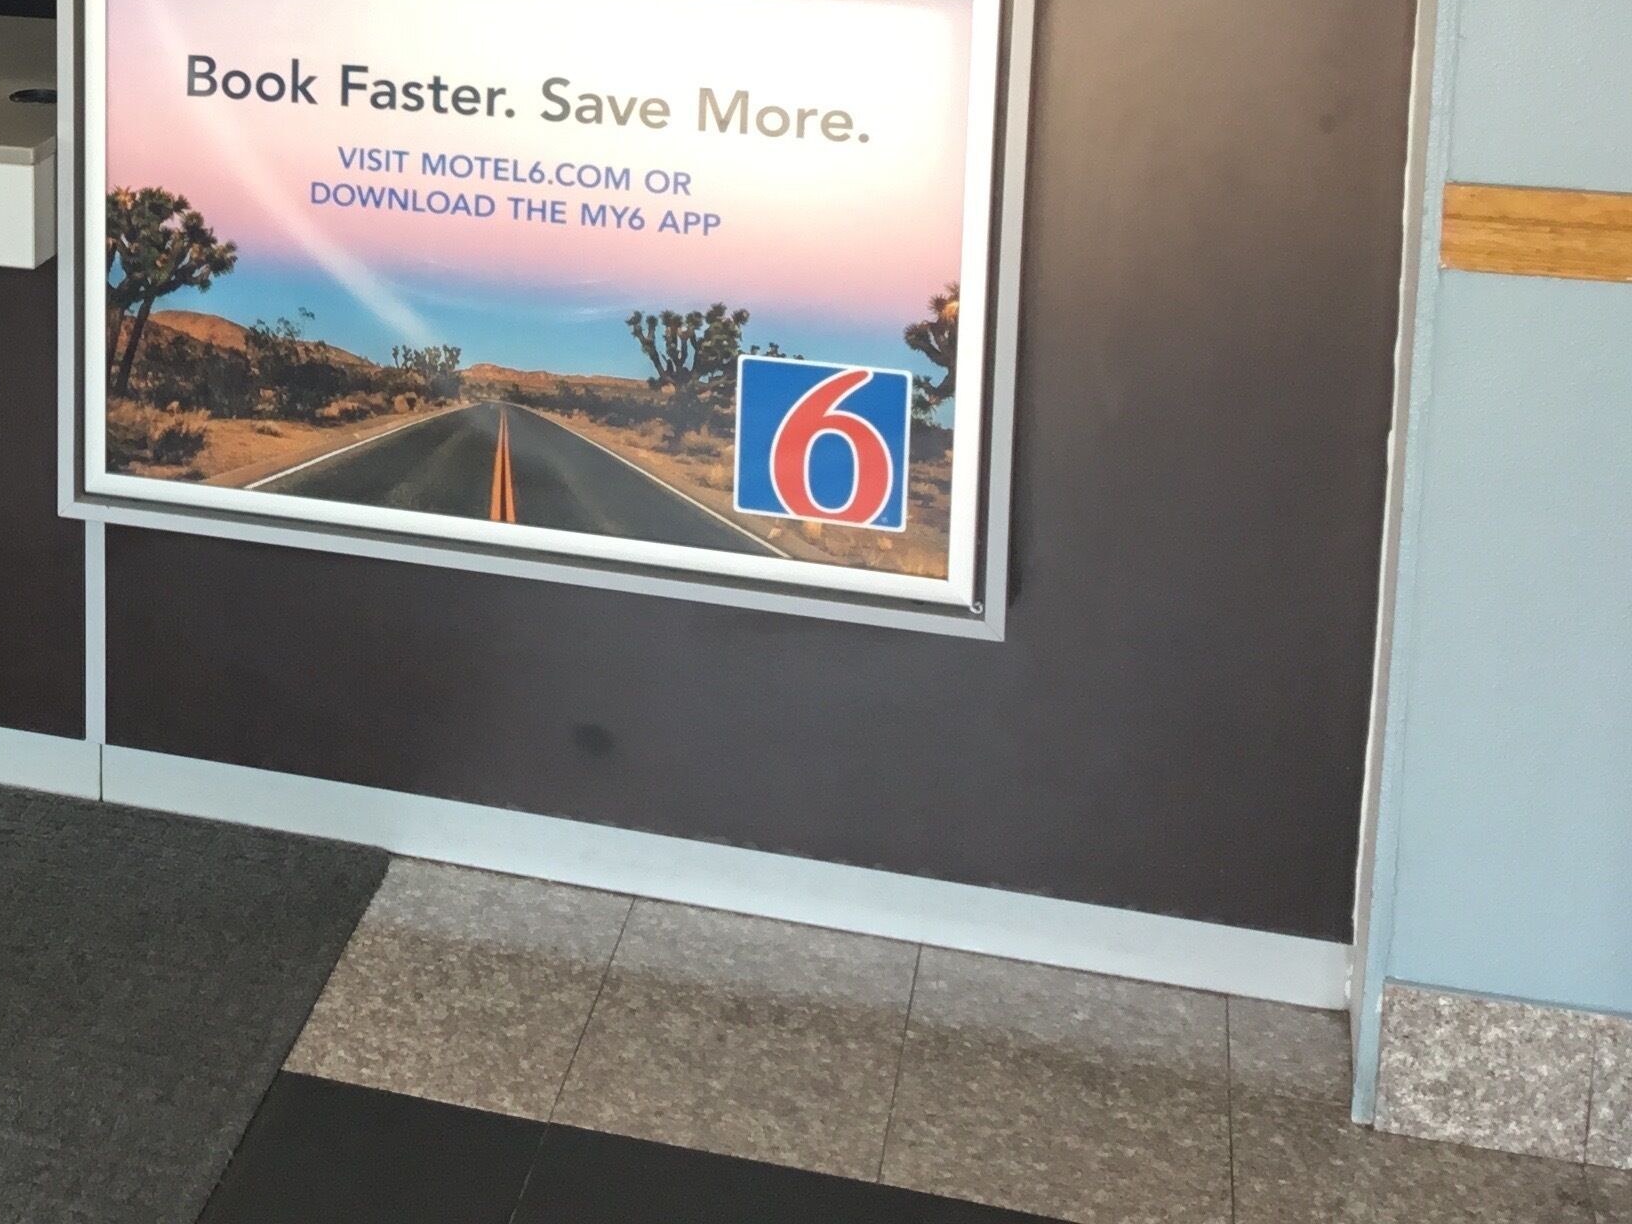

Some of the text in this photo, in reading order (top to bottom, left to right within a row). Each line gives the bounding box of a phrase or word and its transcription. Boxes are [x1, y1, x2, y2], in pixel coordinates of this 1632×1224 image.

[186, 54, 871, 144] Book Faster. Save More.
[337, 146, 692, 197] VISIT MOTEL6.COM OR
[310, 182, 722, 238] DOWNLOAD THE MY6 APP
[770, 367, 893, 526] 6
